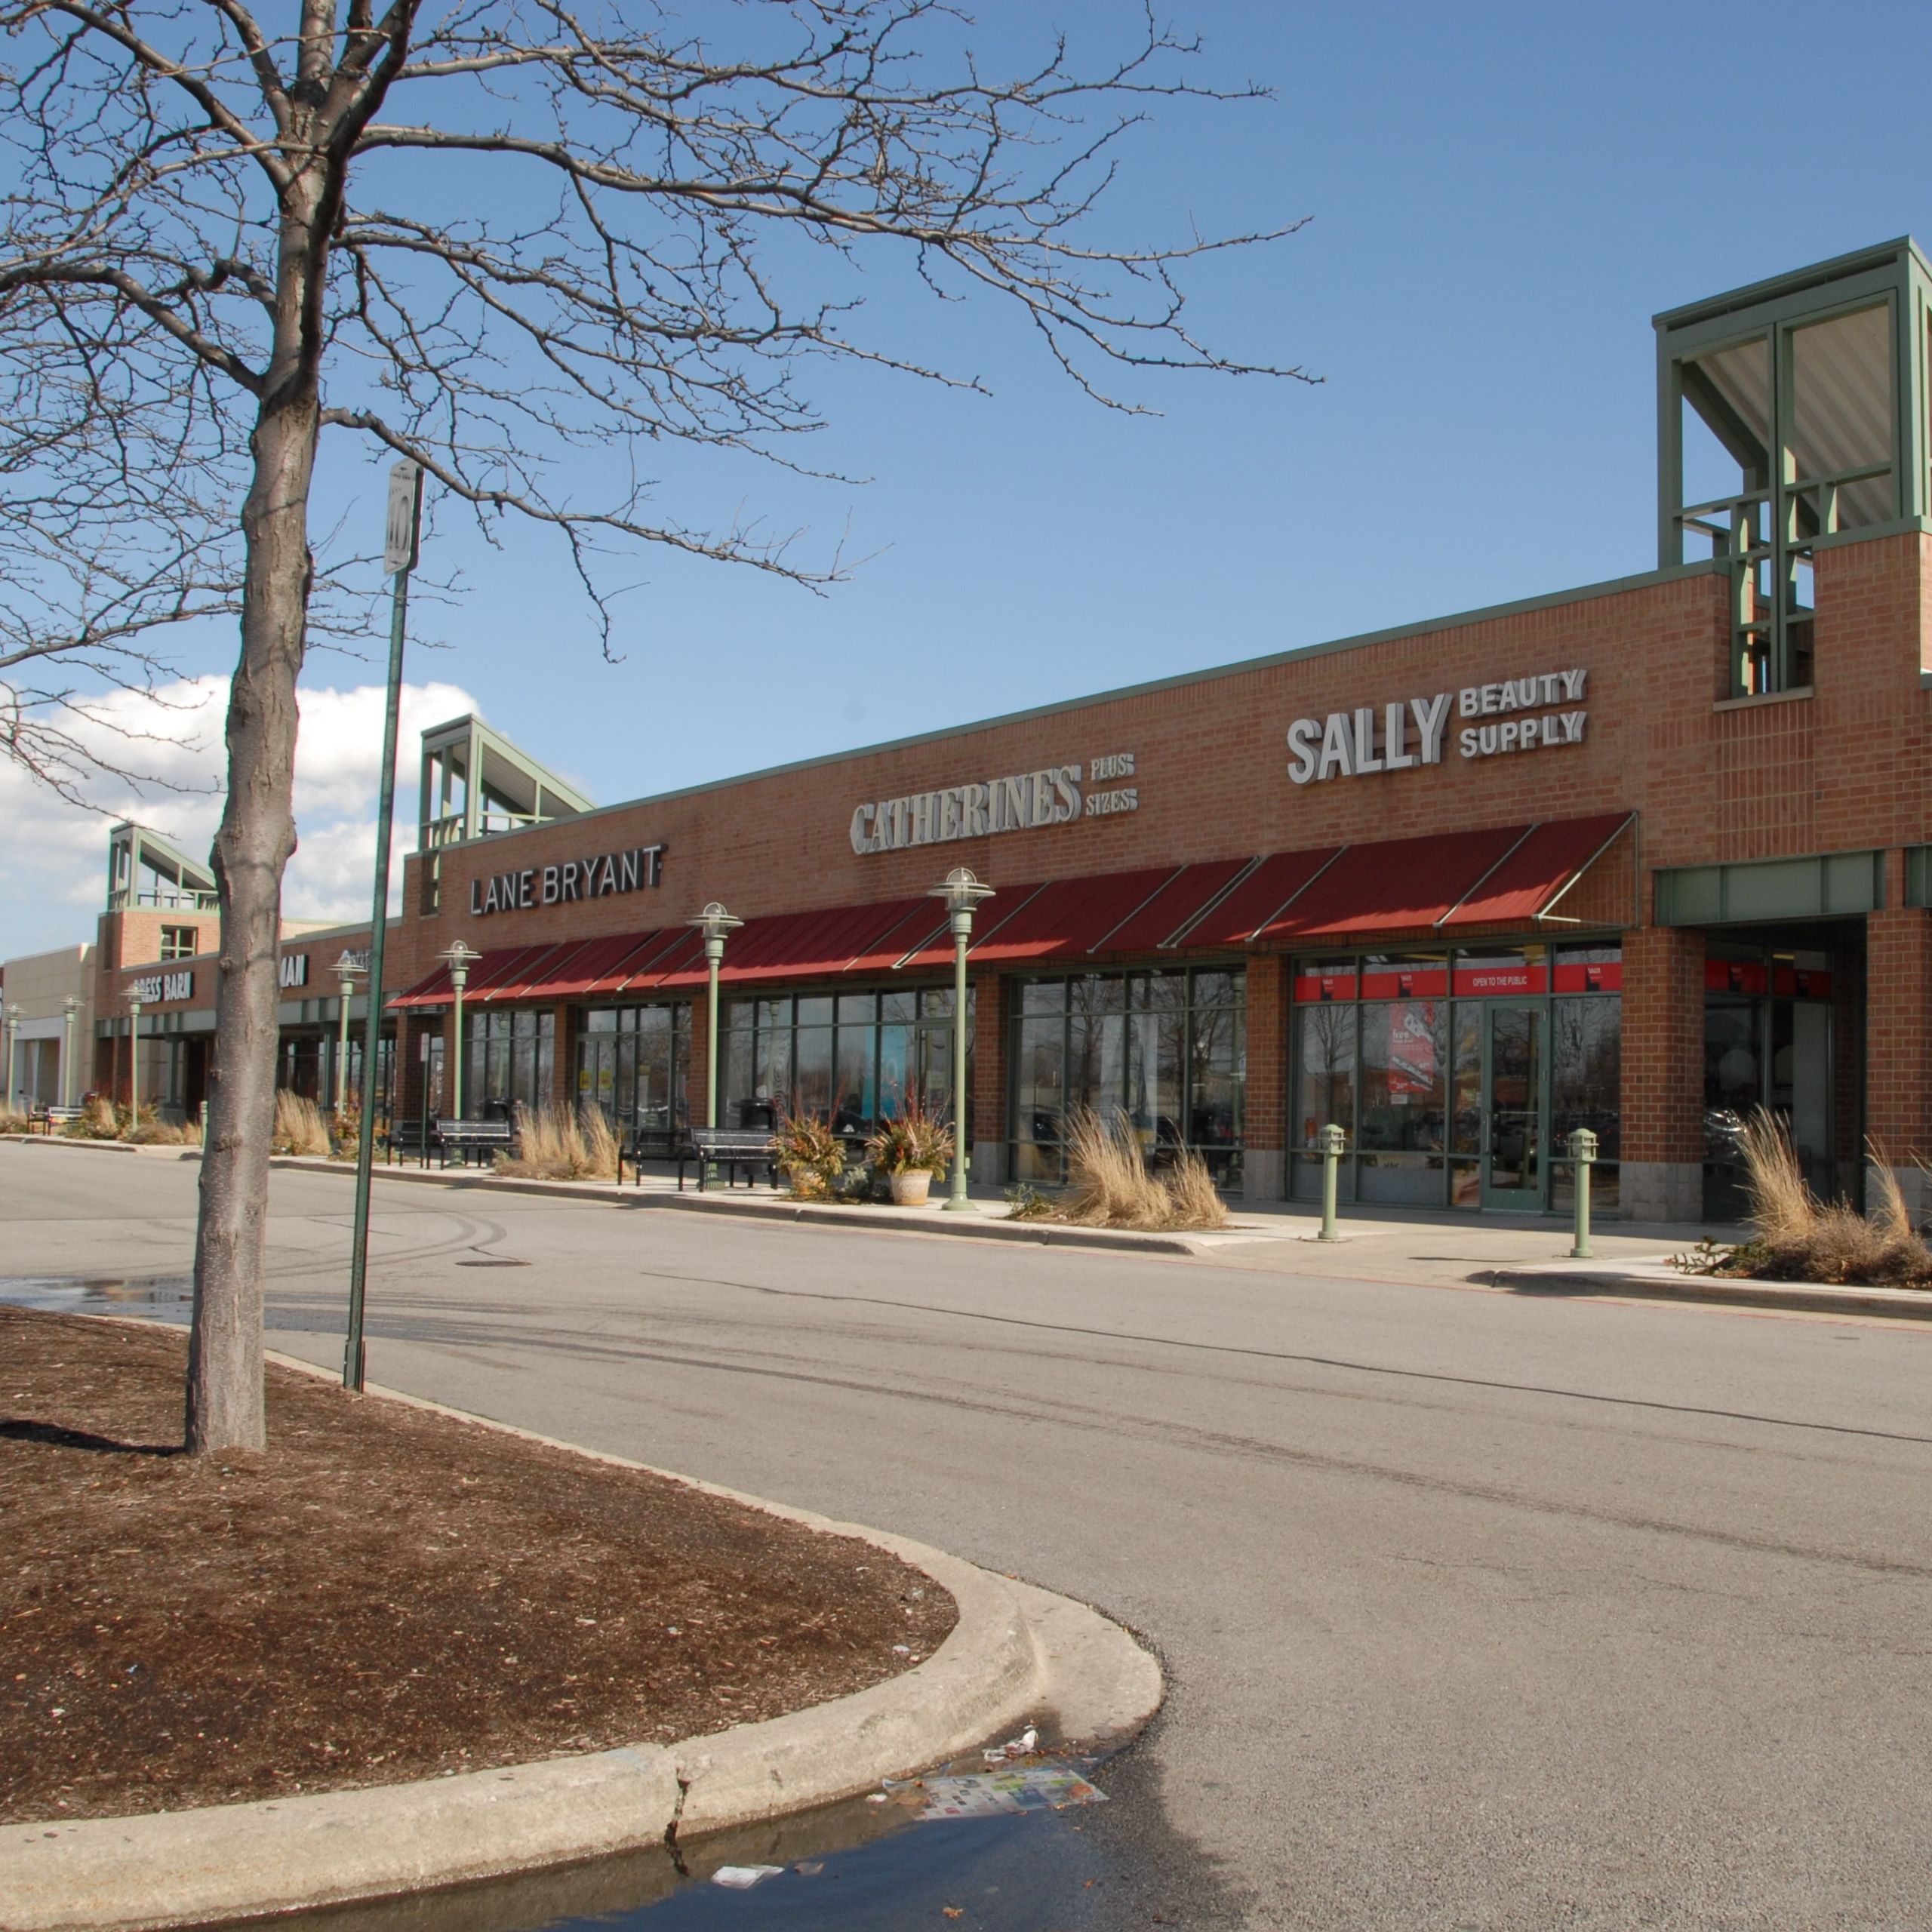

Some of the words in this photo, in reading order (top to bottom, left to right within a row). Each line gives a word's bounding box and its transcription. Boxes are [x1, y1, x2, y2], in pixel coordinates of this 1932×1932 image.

[1459, 669, 1587, 718] BEAUTY
[1287, 694, 1453, 785] SALLY
[1459, 711, 1586, 758] SUPPLY
[1091, 753, 1134, 781] PLUS
[850, 764, 1081, 856] CATHERINES
[1085, 789, 1138, 817] SIZES
[470, 870, 537, 915] LANE
[543, 844, 666, 904] BRYANT
[164, 971, 192, 1001] BARN
[1472, 977, 1487, 987] OPEN
[1488, 977, 1496, 986] TO
[1497, 976, 1507, 986] THE
[1508, 975, 1527, 986] PUBLIC
